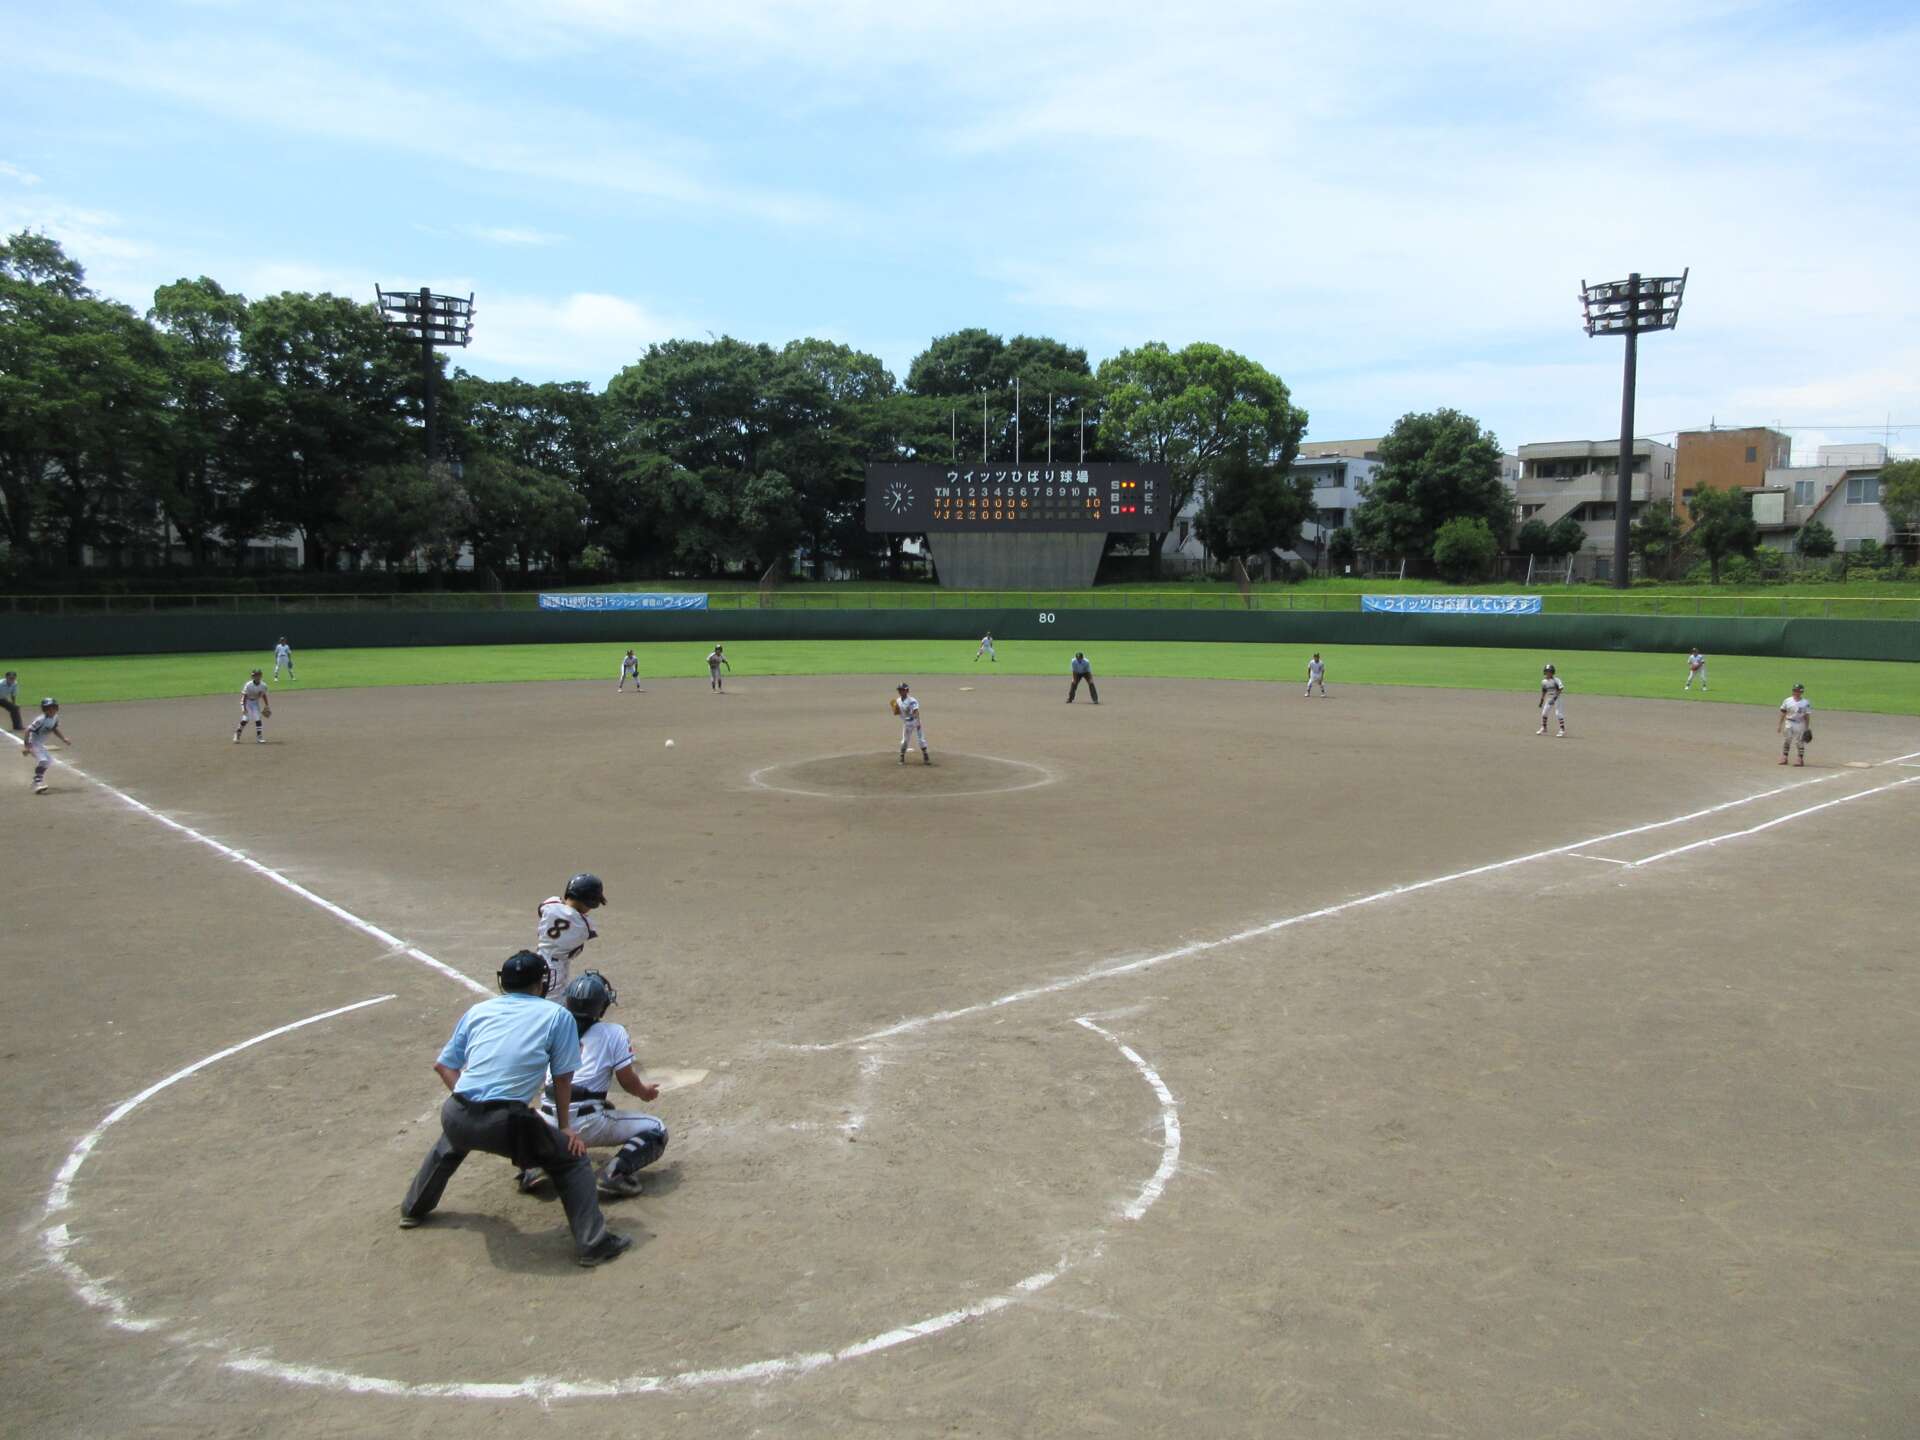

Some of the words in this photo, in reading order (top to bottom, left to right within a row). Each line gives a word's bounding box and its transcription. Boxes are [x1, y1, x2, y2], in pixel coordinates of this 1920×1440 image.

[947, 470, 1089, 483] ウイッツひばり球場
[1111, 480, 1119, 489] S
[1144, 480, 1153, 490] H
[955, 487, 961, 496] 1
[968, 487, 975, 496] 2
[981, 487, 988, 496] 3
[993, 487, 1001, 496] 4
[1007, 487, 1014, 496] 5
[1020, 487, 1027, 496] 6
[1033, 487, 1040, 496] 7
[1046, 487, 1053, 496] 8
[1059, 487, 1066, 496] 9
[1071, 487, 1080, 496] 10
[1088, 487, 1097, 496] R
[1144, 493, 1153, 502] E
[969, 498, 976, 508] 4
[982, 498, 989, 508] 0
[995, 498, 1002, 508] 0
[1086, 498, 1101, 508] 10
[982, 510, 989, 520] 0
[995, 510, 1002, 520] 0
[1008, 510, 1015, 520] 0
[1038, 612, 1055, 623] 80
[547, 918, 570, 939] 8
